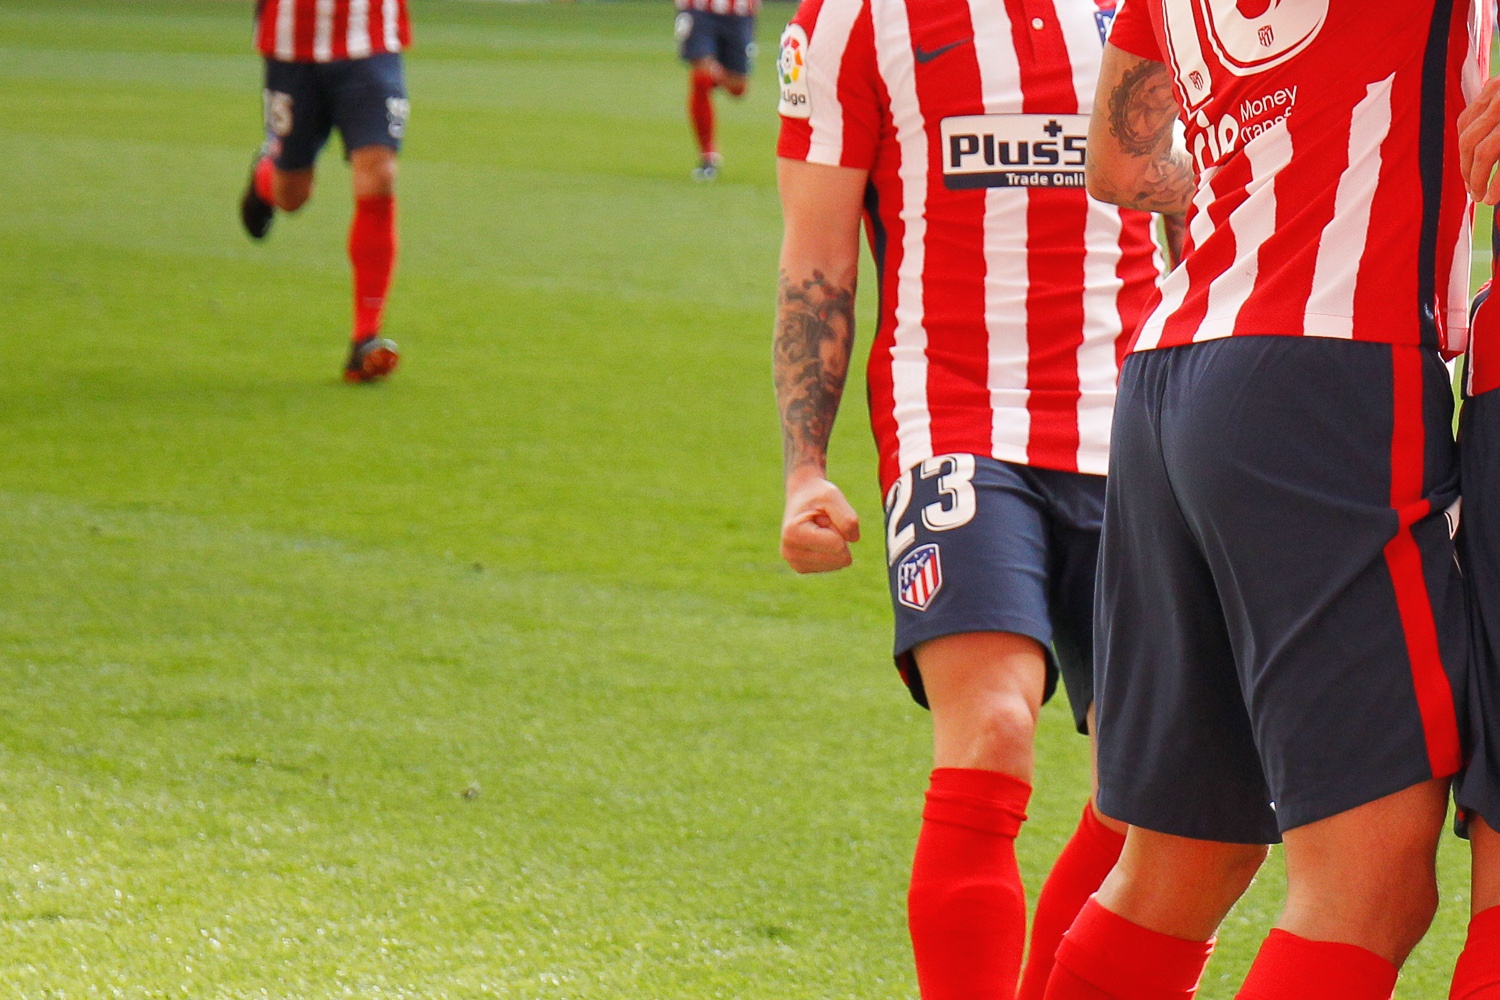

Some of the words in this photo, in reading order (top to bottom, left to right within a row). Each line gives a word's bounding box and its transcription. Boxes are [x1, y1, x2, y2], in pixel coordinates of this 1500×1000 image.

[1240, 85, 1297, 122] Money
[950, 132, 1087, 168] Plus5
[1006, 173, 1049, 186] Trade
[1053, 172, 1086, 186] Onli
[885, 453, 977, 568] 23
